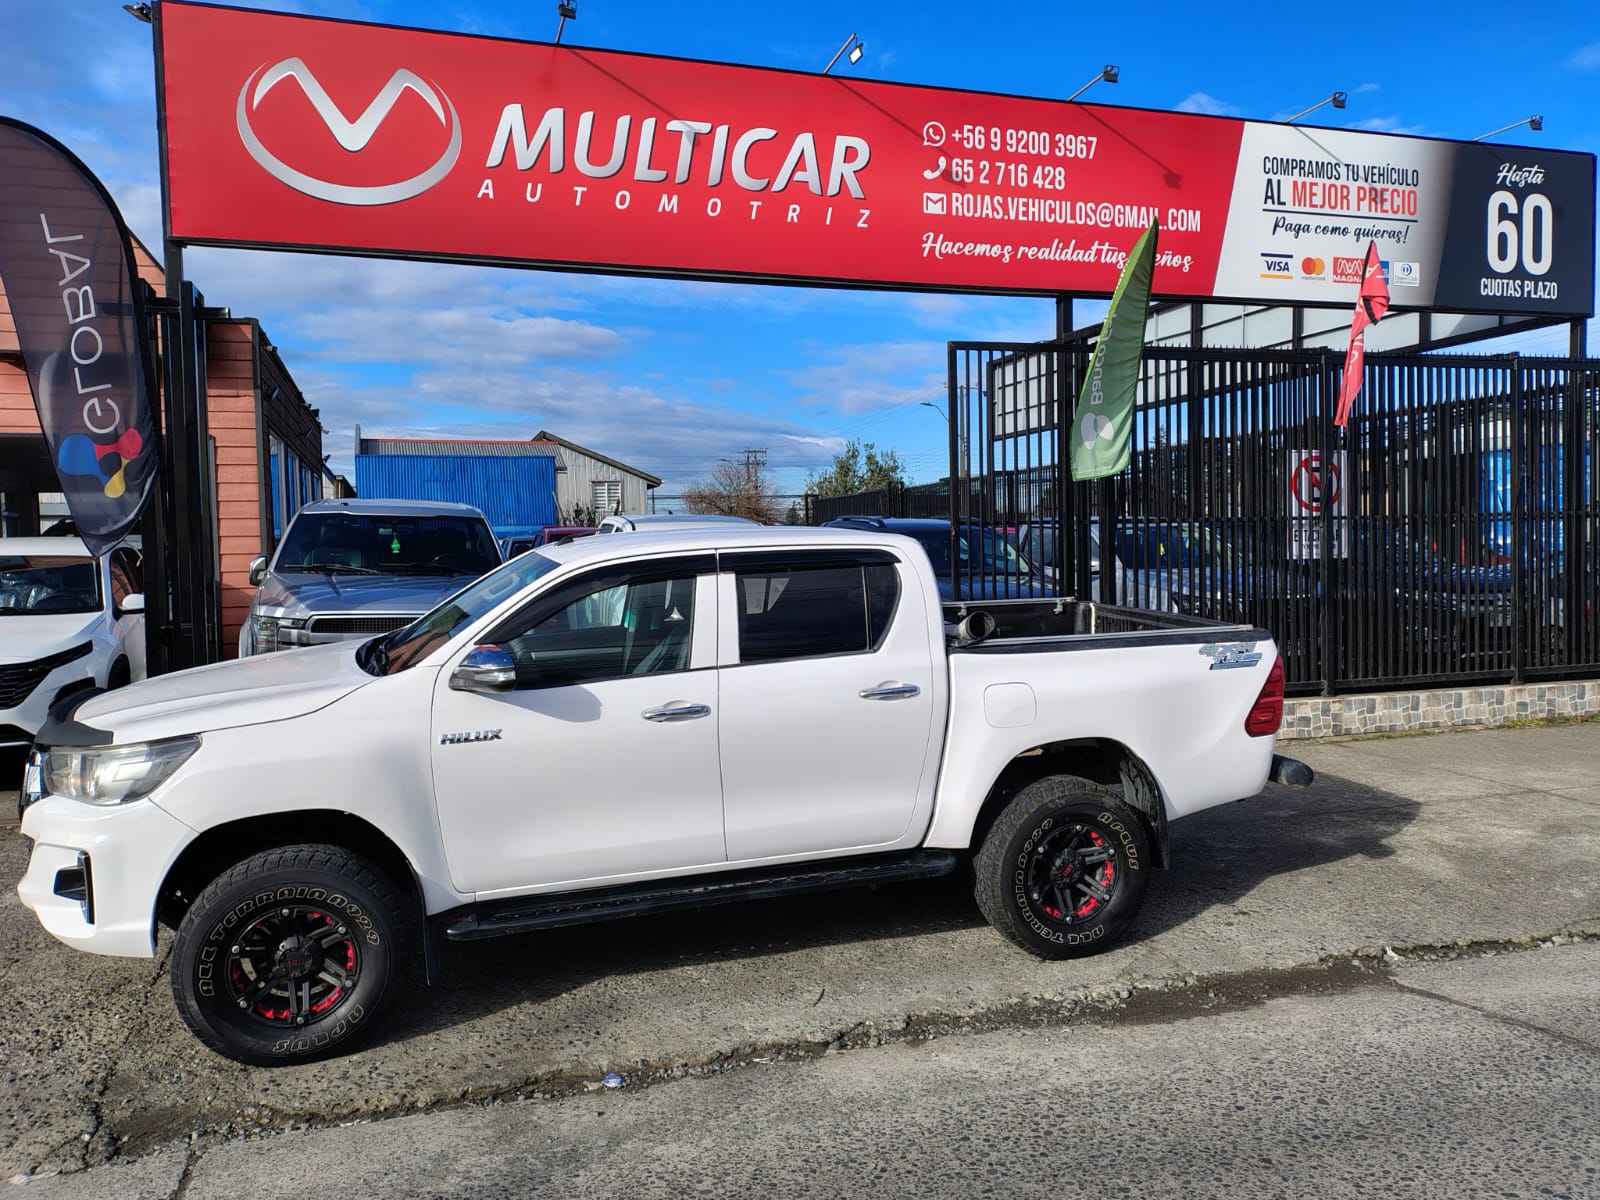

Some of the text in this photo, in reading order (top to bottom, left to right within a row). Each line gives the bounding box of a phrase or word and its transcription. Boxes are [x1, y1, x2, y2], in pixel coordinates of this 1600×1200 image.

[485, 103, 871, 200] MULTICAR
[952, 124, 1098, 159] +56 9 9200 3967
[952, 158, 1065, 190] 65 2 716 428
[1263, 156, 1419, 187] COMPRAMOS TU VEHÍCULO
[1496, 162, 1545, 188] Hasta
[477, 178, 871, 228] AUTOMOTRIZ
[1264, 178, 1418, 216] AL MEJOR PRECIO
[1272, 216, 1410, 244] Paga como quieras!
[1487, 190, 1553, 275] 60
[921, 231, 1014, 263] Hacemos
[1017, 239, 1096, 264] realidad
[1093, 242, 1128, 269] tus
[1265, 260, 1290, 273] VISA
[1480, 278, 1558, 300] CUOTAS PLAZO
[440, 728, 503, 745] HILUX
[1096, 812, 1139, 871] APLUS
[199, 946, 218, 997] ALL
[210, 886, 327, 942] TERRAIN
[272, 1003, 364, 1053] APLUS
